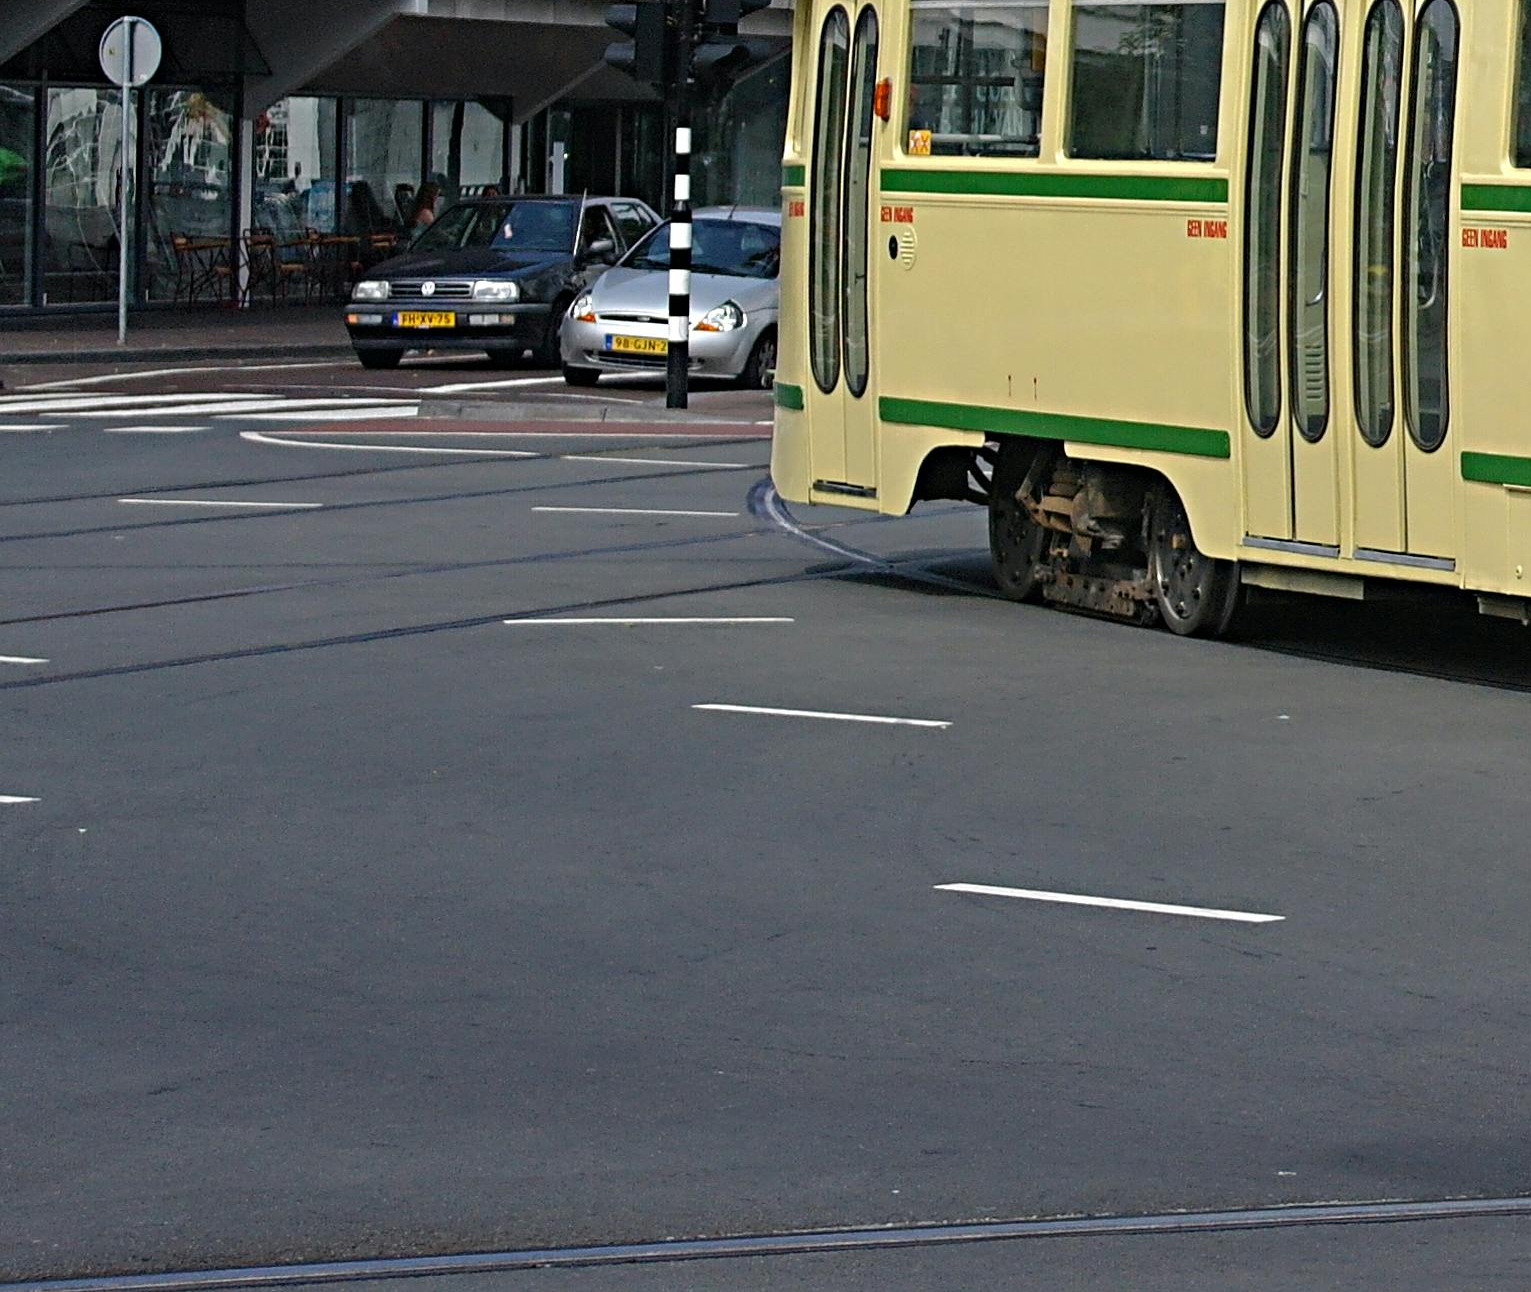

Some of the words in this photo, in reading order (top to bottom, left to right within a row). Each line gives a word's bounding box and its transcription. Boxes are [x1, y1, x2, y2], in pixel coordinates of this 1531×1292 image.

[1203, 220, 1227, 239] INGANG
[1462, 228, 1479, 247] GEEN
[1480, 229, 1507, 249] INGANG
